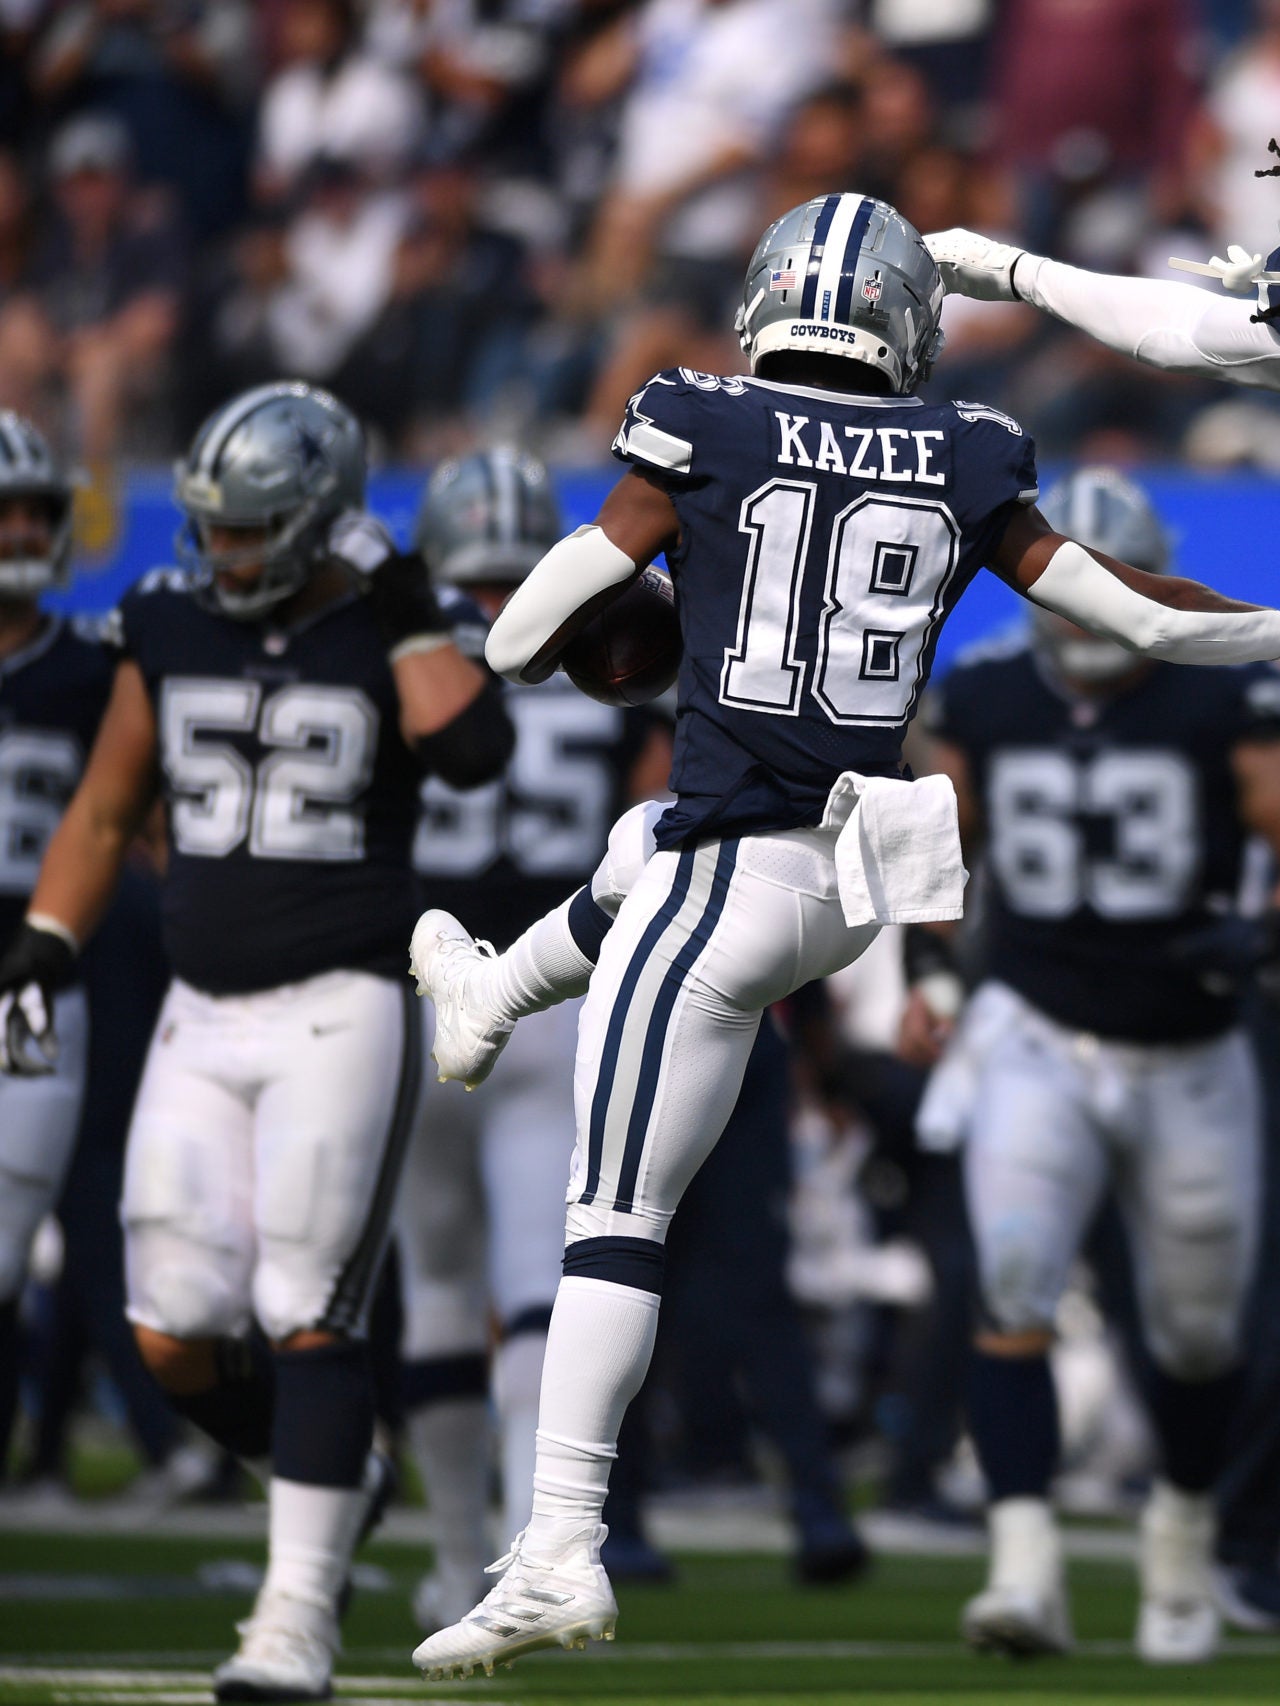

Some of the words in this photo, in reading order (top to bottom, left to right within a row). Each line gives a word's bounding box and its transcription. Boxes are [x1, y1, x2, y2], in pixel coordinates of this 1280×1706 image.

[791, 325, 855, 343] COWBOYS
[774, 411, 946, 485] KAZEE
[718, 477, 962, 727] 18
[160, 676, 379, 860] 52
[989, 750, 1196, 921] 63
